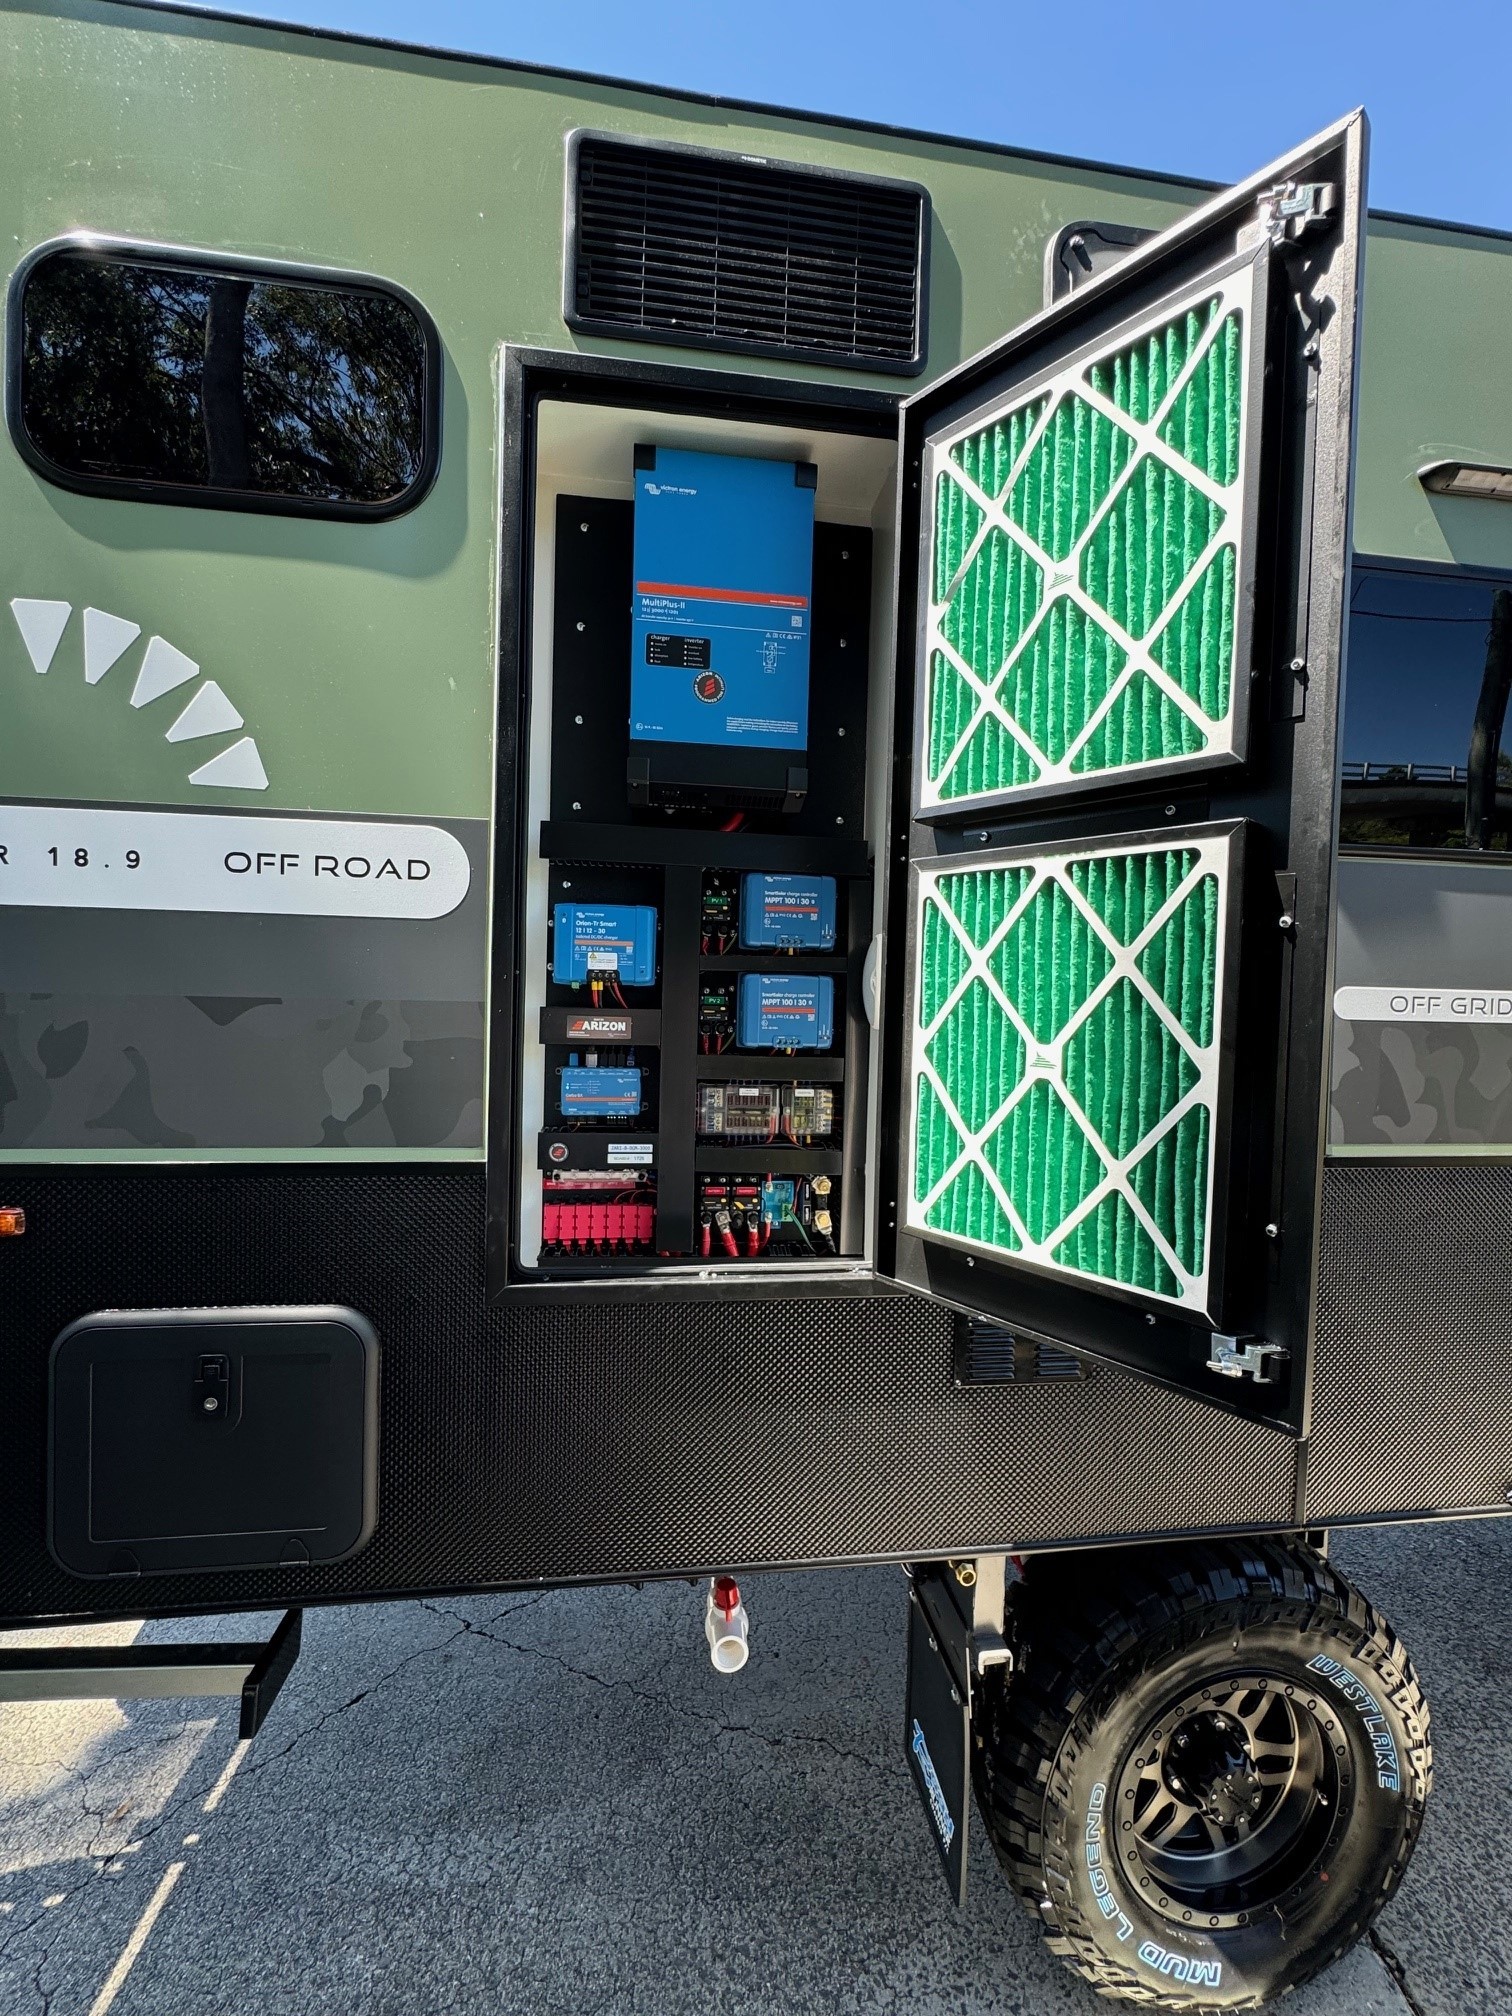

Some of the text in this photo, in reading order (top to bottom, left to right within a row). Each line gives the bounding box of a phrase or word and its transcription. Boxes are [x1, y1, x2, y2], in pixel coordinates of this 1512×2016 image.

[642, 598, 685, 608] MultiPlus-II
[224, 851, 431, 880] OFF ROAD
[1390, 996, 1512, 1015] OFF GRID
[582, 1020, 626, 1031] ARIZON
[1306, 1654, 1400, 1792] WESTLAKE
[1085, 1783, 1221, 1986] MUD LEGEND
